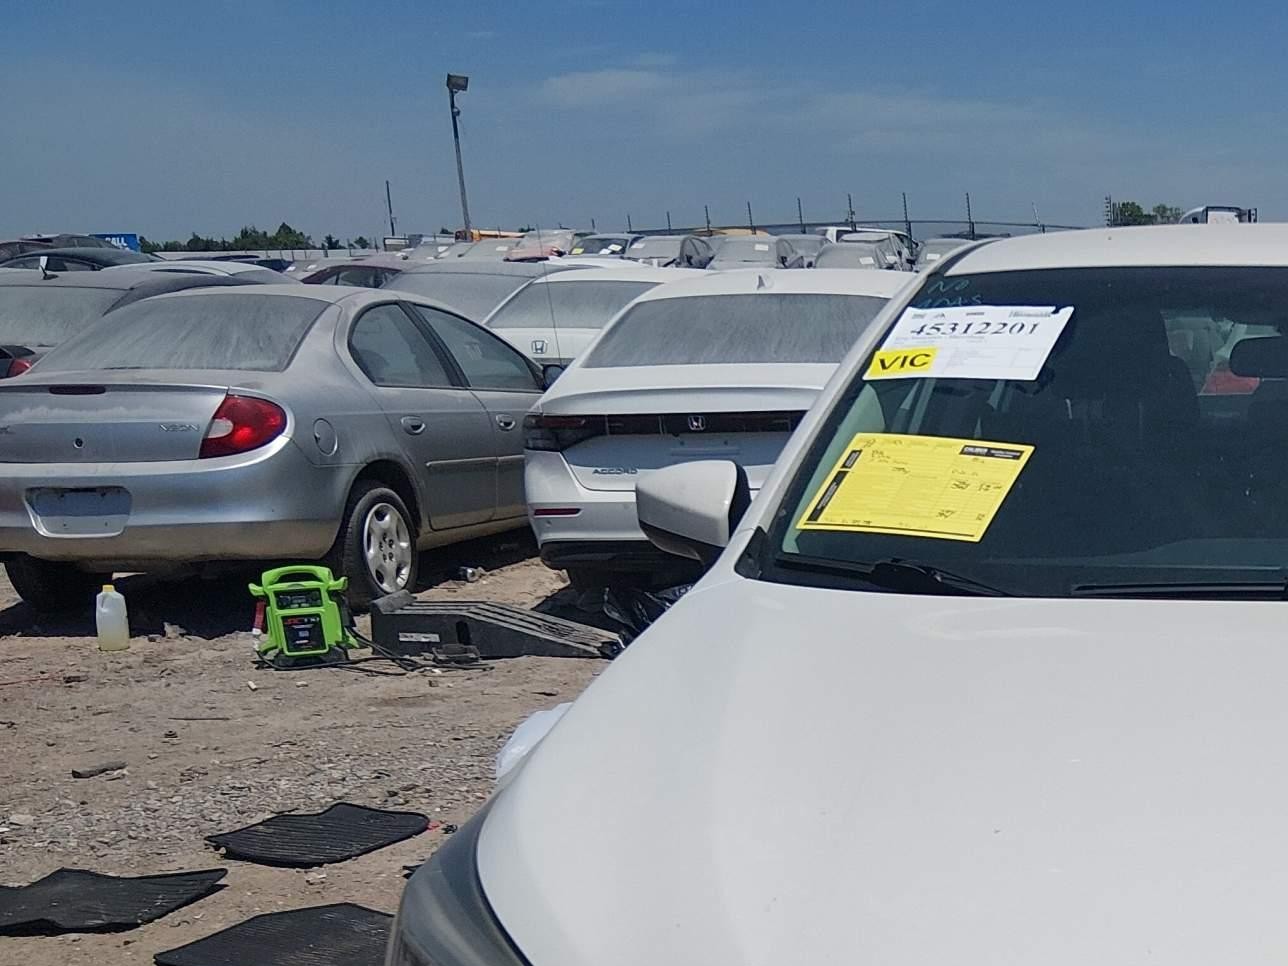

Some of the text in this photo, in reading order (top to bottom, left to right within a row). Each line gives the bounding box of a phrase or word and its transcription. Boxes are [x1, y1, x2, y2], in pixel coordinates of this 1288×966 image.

[910, 322, 1040, 336] 45312201
[878, 353, 931, 371] VIC
[159, 423, 200, 432] NEON
